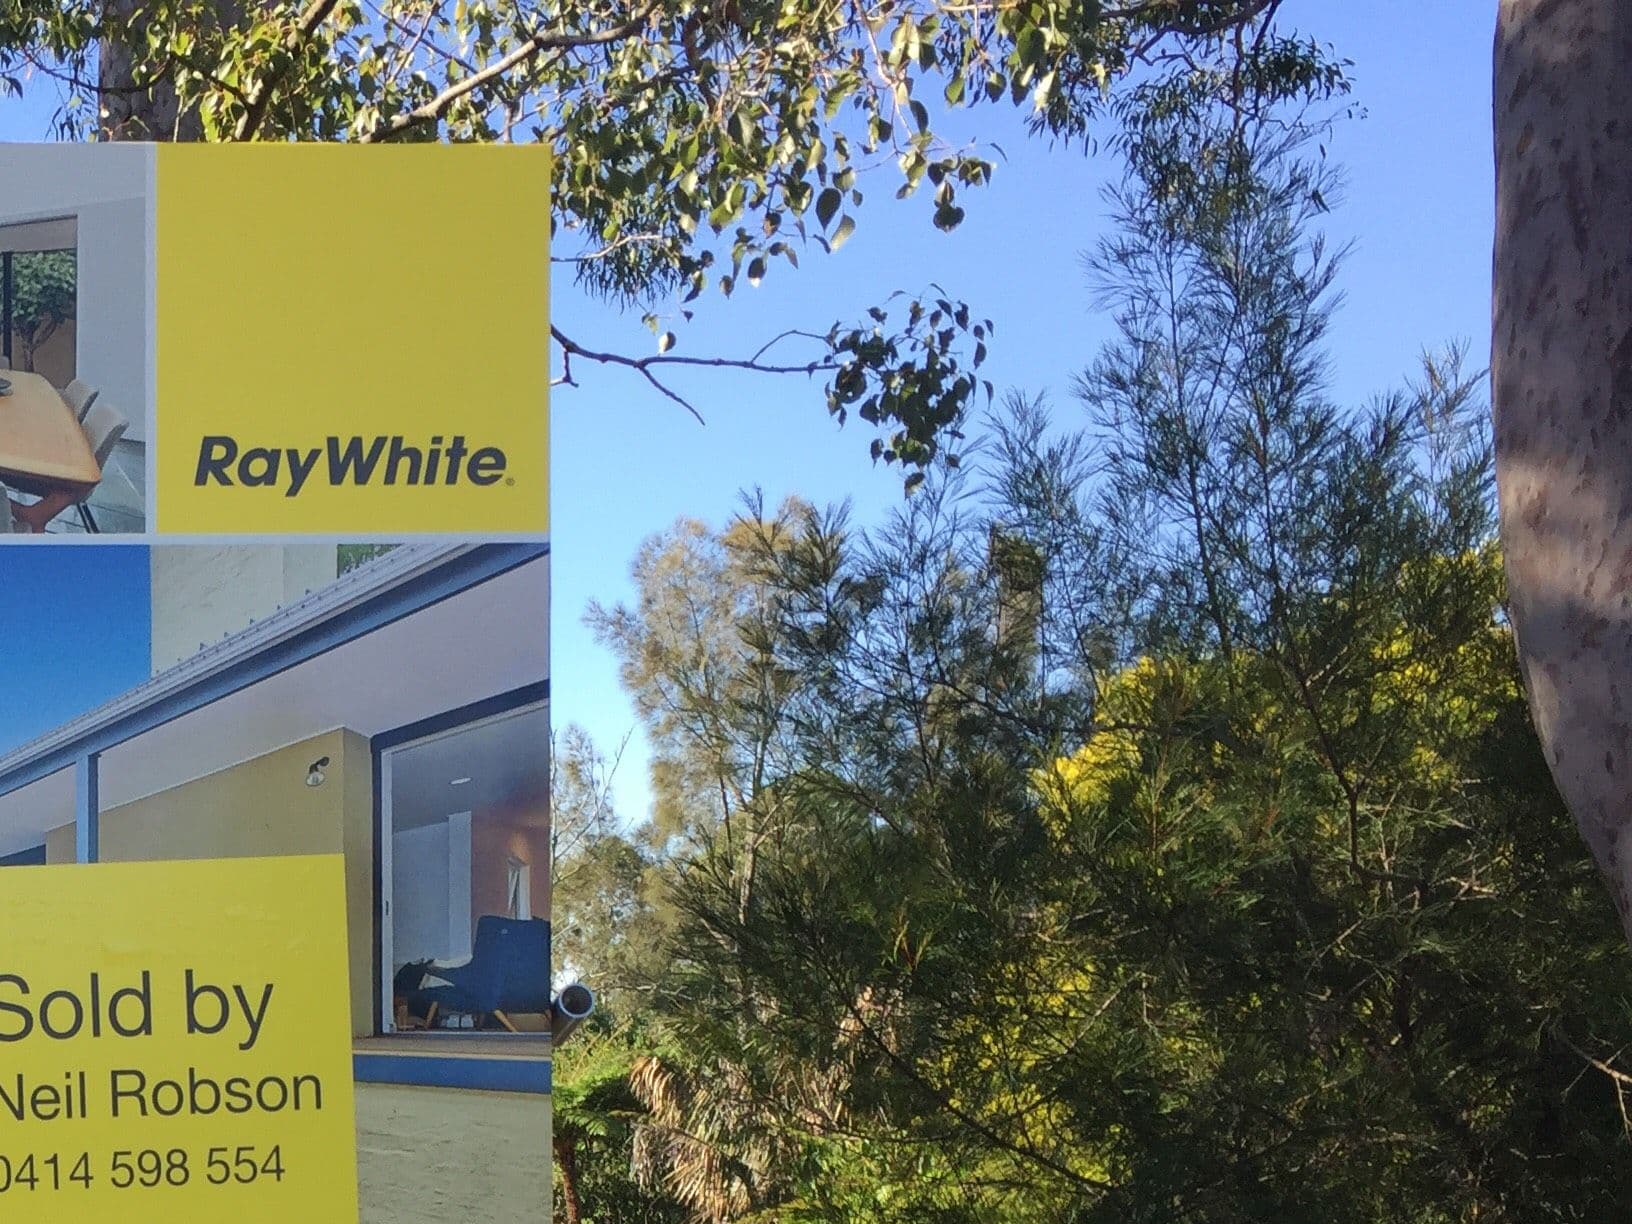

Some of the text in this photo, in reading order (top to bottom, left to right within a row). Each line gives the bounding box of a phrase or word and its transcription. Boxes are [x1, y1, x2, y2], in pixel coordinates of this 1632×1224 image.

[184, 968, 274, 1051] by
[110, 1066, 322, 1118] Robson
[110, 1148, 190, 1189] 598
[206, 1144, 286, 1185] 554
